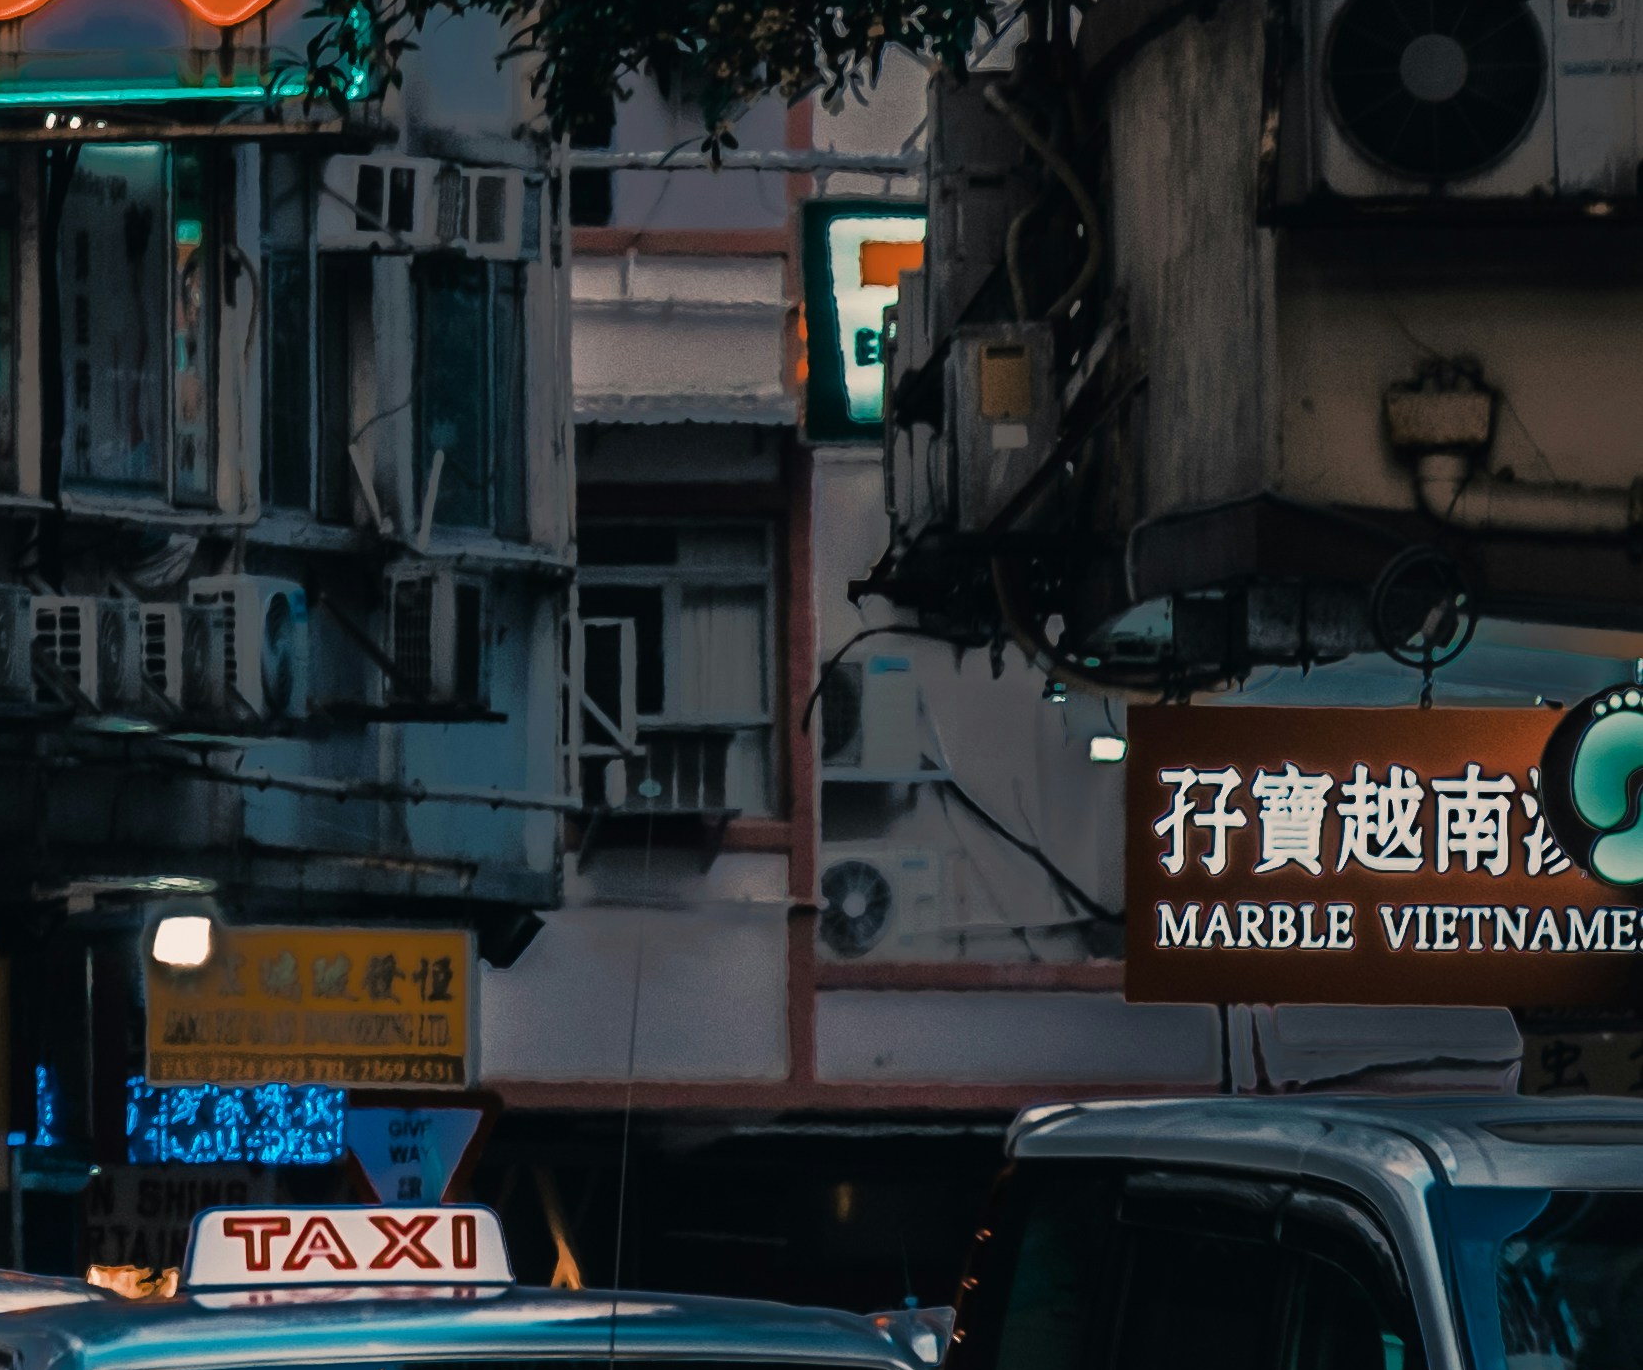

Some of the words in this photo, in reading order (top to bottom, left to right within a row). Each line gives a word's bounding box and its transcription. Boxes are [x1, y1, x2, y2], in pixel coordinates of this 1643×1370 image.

[1157, 901, 1355, 950] MARBLE
[1380, 905, 1643, 952] VIETNAME
[223, 1214, 477, 1271] TAXI
